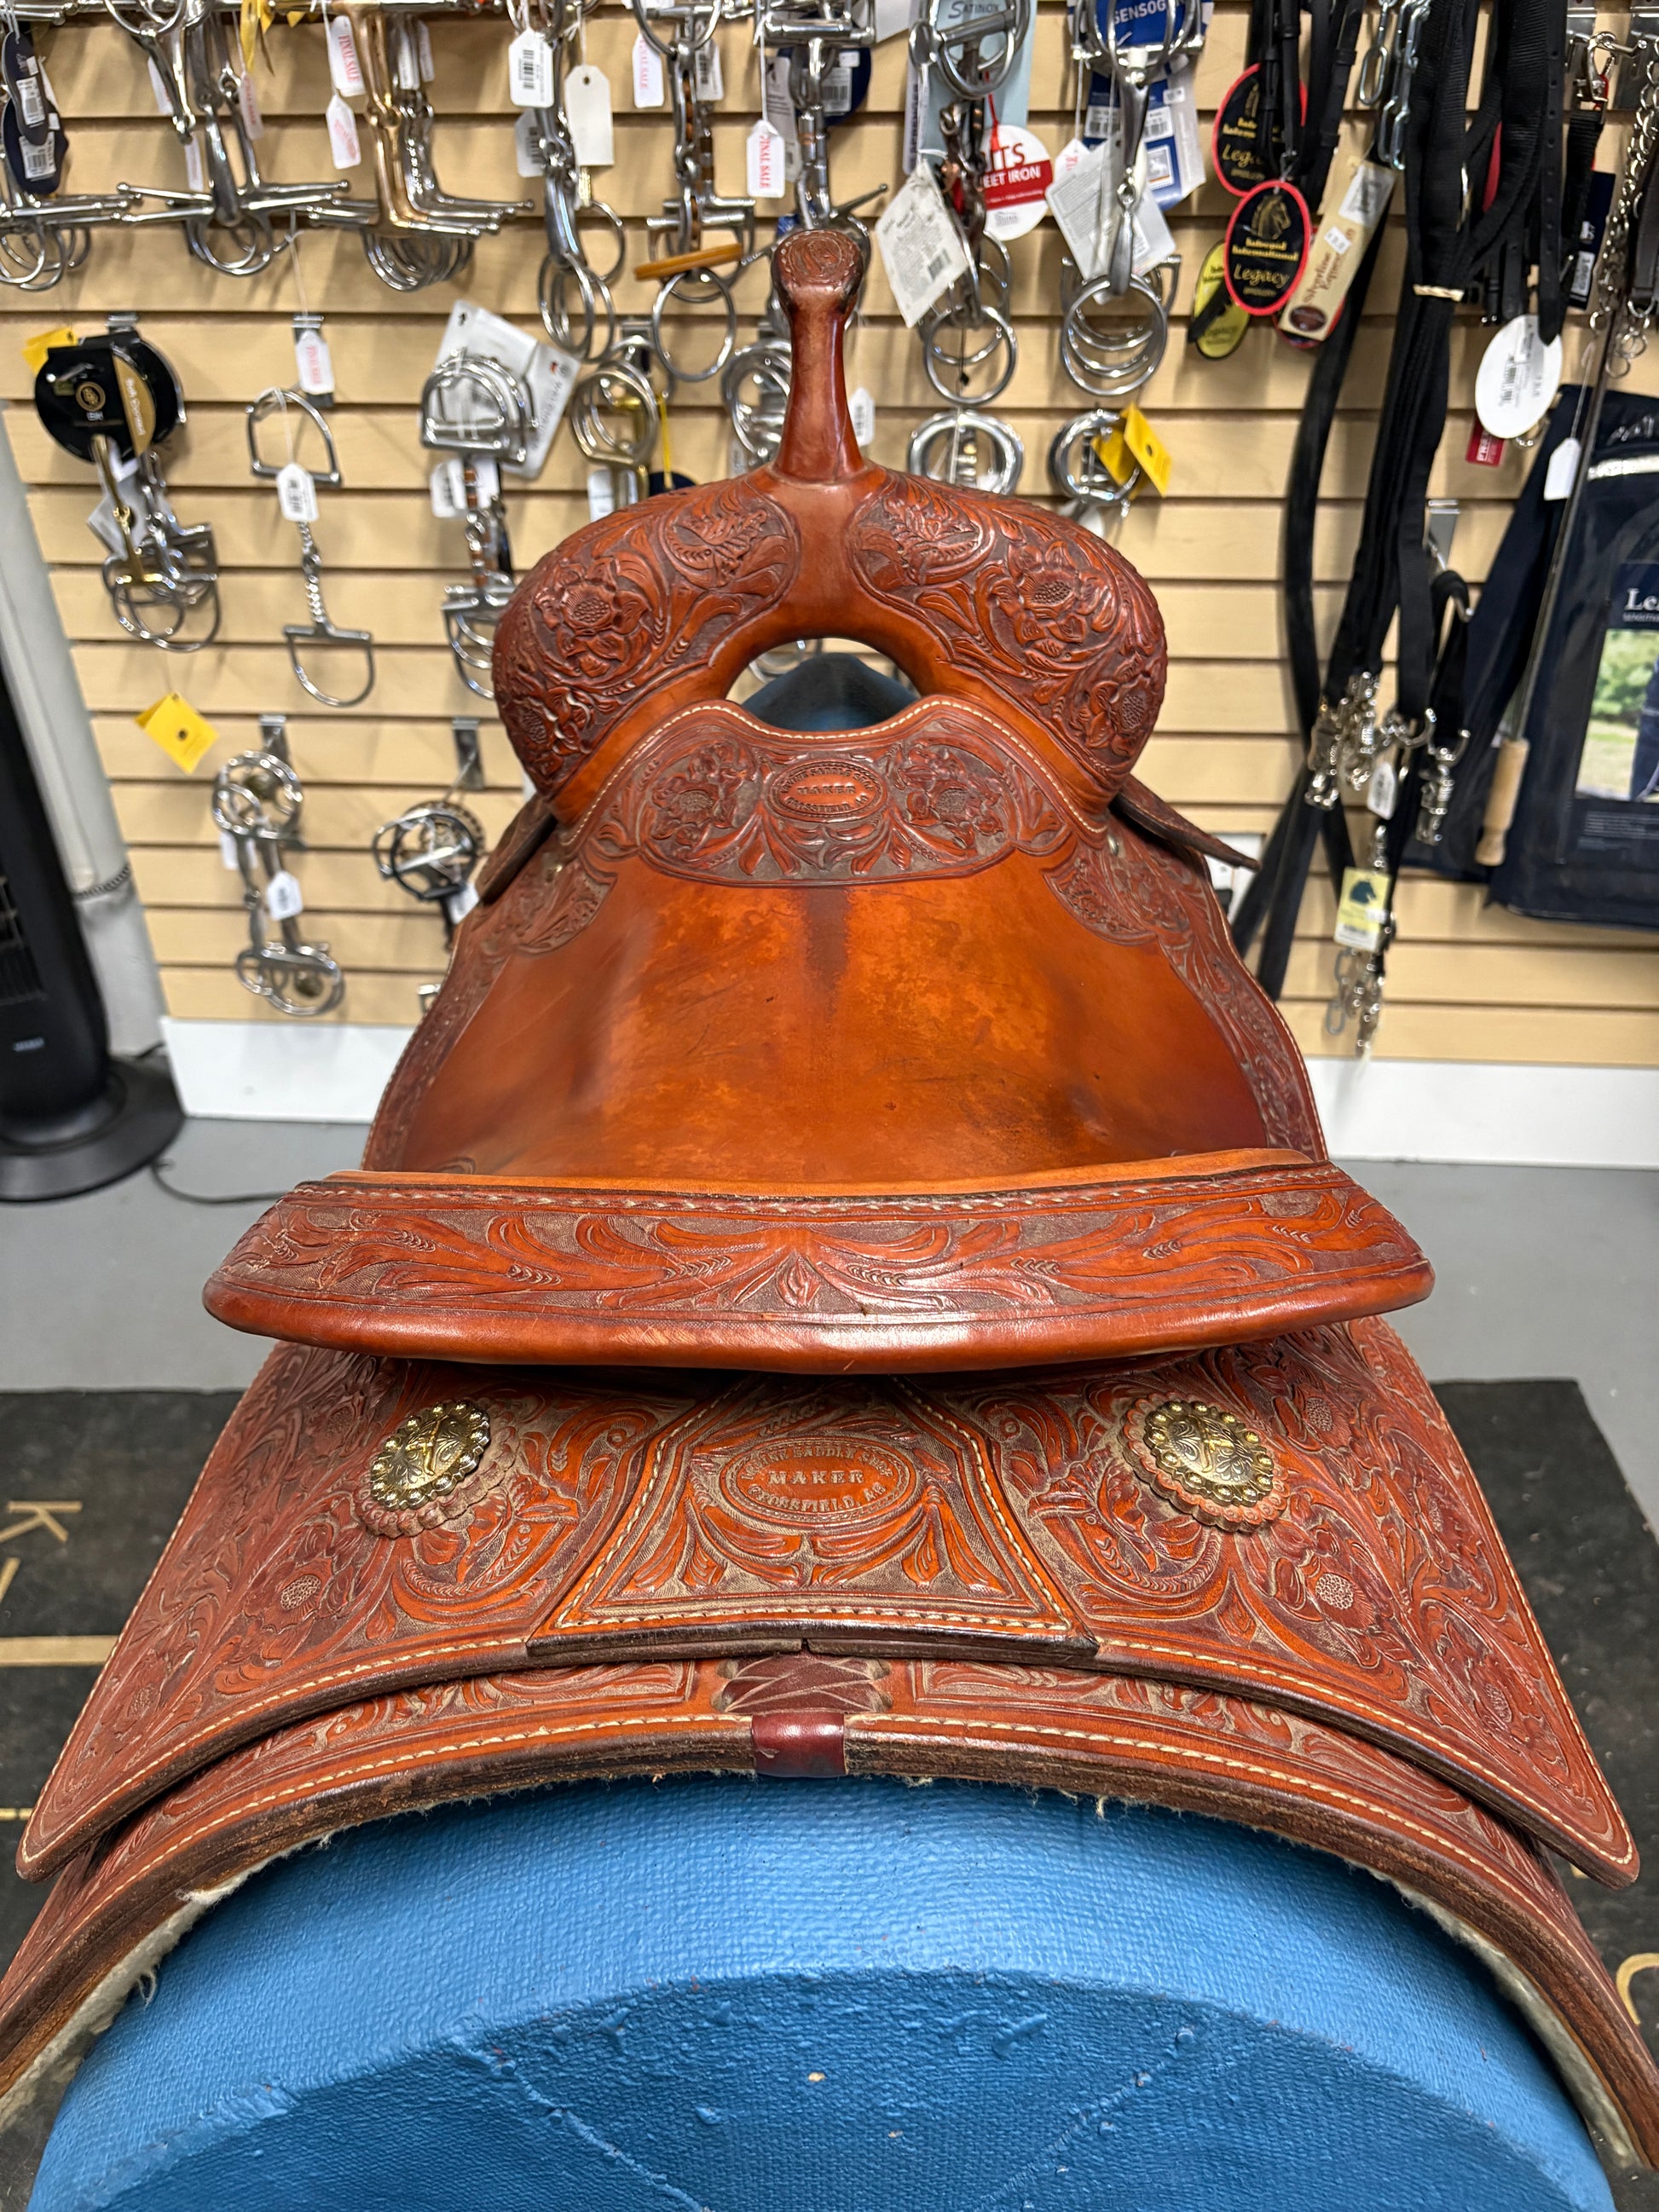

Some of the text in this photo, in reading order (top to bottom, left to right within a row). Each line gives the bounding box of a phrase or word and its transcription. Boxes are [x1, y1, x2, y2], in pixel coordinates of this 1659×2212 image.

[983, 142, 1026, 171] ITS
[1008, 165, 1042, 184] IRON
[1234, 263, 1290, 289] Legacy
[796, 783, 856, 794] MAKER
[793, 1446, 857, 1459] SADDLE
[858, 1451, 893, 1477] SHOP
[768, 1470, 864, 1485] MAKER
[863, 1481, 887, 1502] AB
